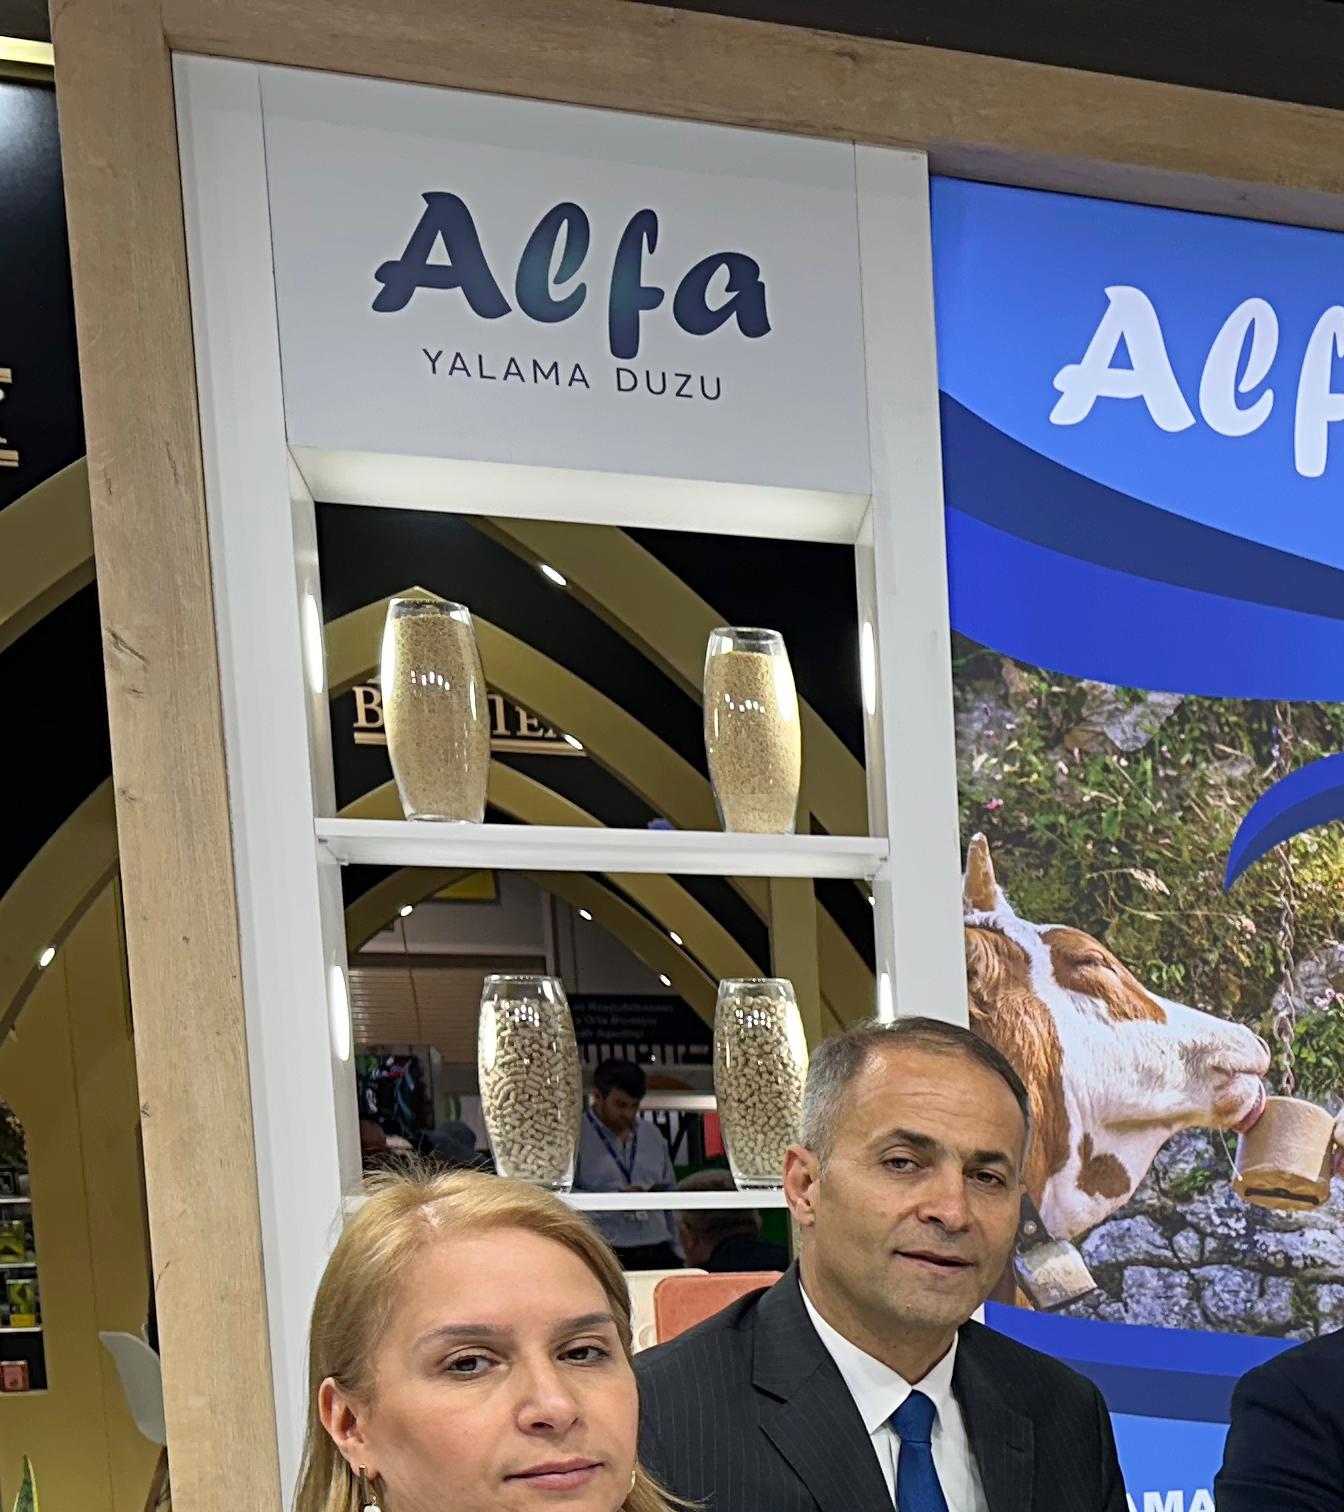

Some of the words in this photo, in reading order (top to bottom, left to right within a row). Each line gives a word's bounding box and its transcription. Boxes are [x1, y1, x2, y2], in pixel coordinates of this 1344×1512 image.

[371, 191, 773, 359] Alfa
[422, 347, 590, 390] YALAMA
[616, 367, 725, 402] DUZU
